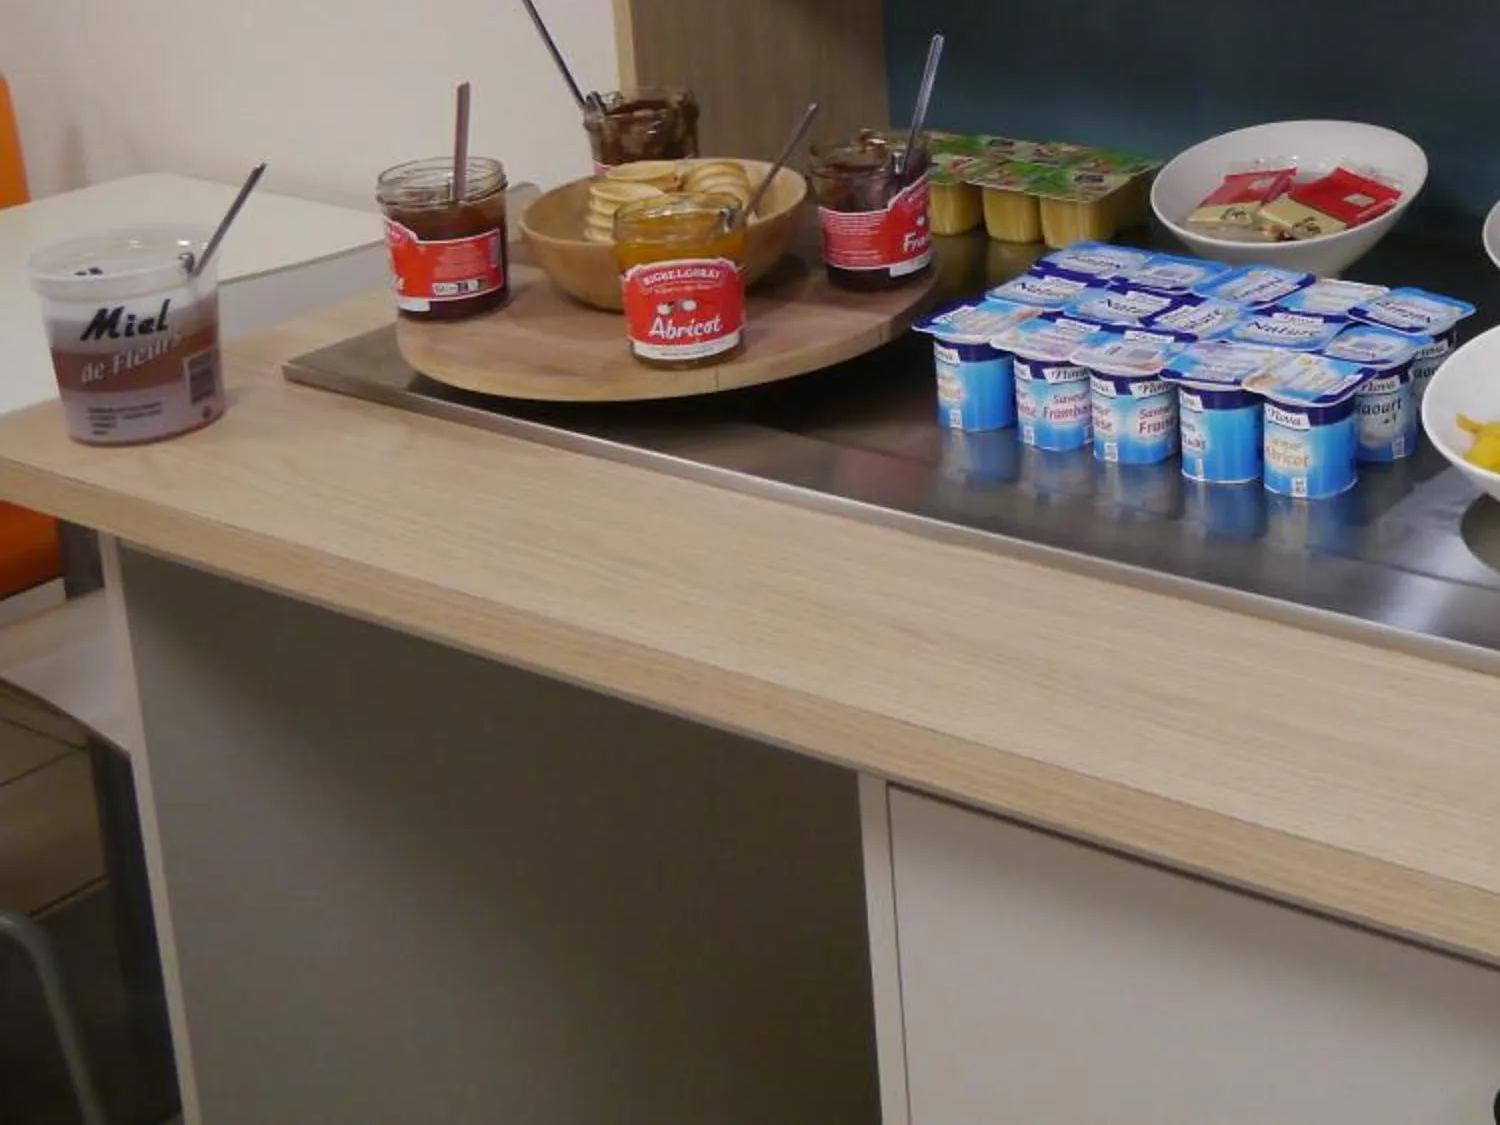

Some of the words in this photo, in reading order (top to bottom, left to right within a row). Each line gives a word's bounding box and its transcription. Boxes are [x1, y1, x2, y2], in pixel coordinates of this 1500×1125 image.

[79, 298, 171, 342] Miel
[648, 315, 722, 340] Abricot
[1249, 321, 1322, 338] Nature
[81, 362, 106, 384] de
[112, 329, 184, 375] Fleurs
